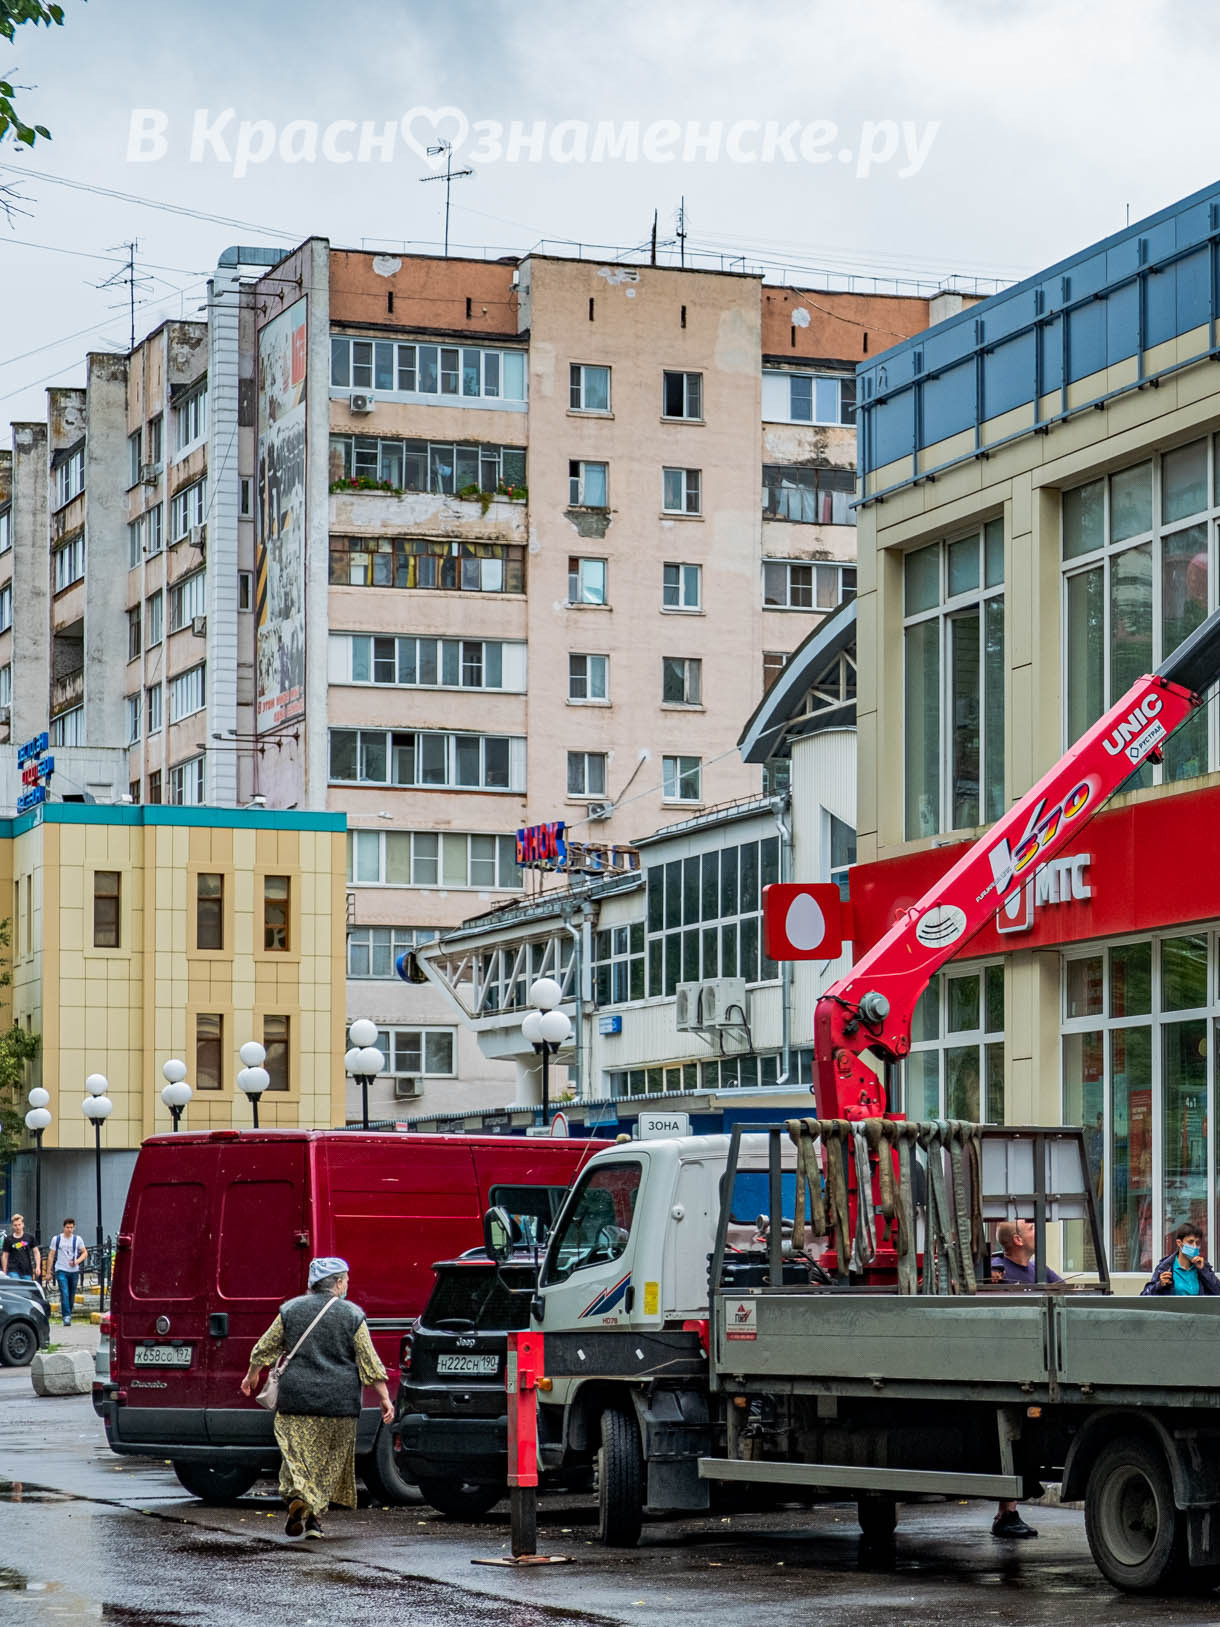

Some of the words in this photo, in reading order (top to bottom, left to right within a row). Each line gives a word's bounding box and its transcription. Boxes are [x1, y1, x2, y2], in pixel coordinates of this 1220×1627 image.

[1102, 693, 1163, 756] UNIC
[1035, 853, 1092, 906] МТС
[648, 1121, 680, 1131] ЗОНА
[456, 1337, 476, 1348] Jeep
